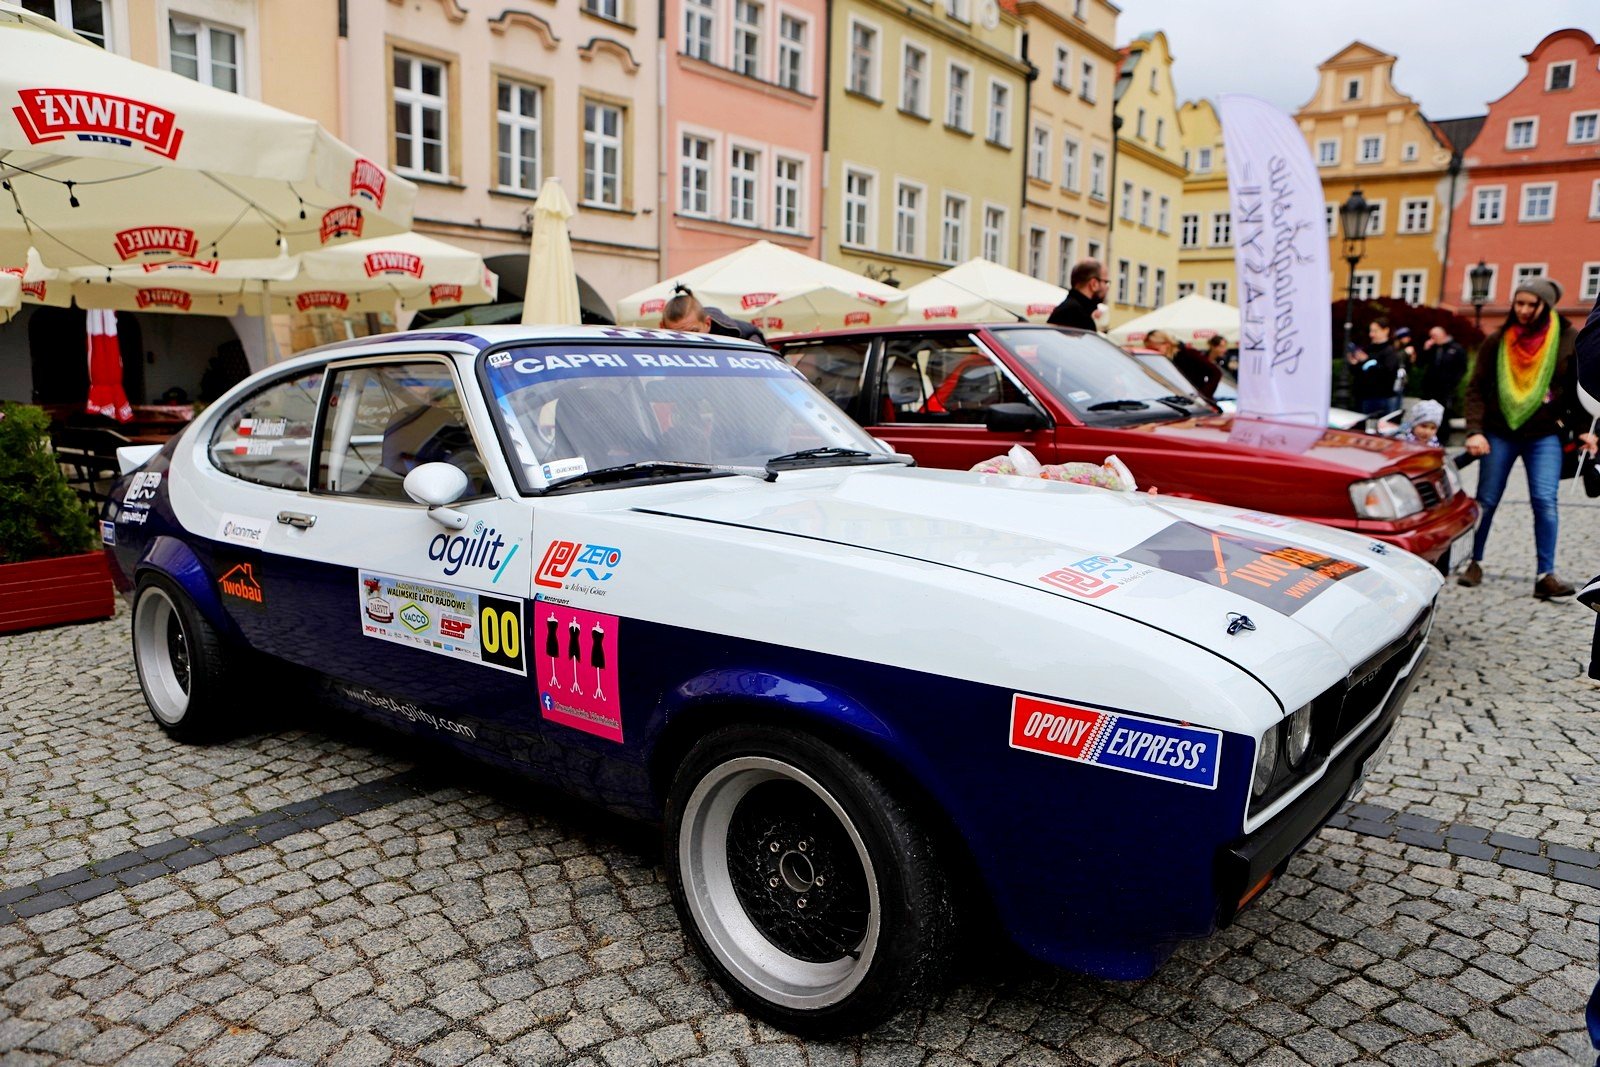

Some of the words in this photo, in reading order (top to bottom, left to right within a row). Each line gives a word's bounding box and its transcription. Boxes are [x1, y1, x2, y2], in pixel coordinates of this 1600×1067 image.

[35, 90, 164, 141] ŻYWIEC
[513, 353, 628, 374] CAPRI
[633, 353, 720, 369] RALLY
[232, 522, 262, 540] konmet
[577, 544, 622, 568] ZETO
[387, 587, 418, 601] WALIMSKIE
[418, 593, 434, 605] LATO
[435, 597, 466, 611] RAJDOWE
[481, 606, 520, 659] 00
[1023, 711, 1092, 747] OPONY
[1106, 727, 1207, 770] EXPRESS
